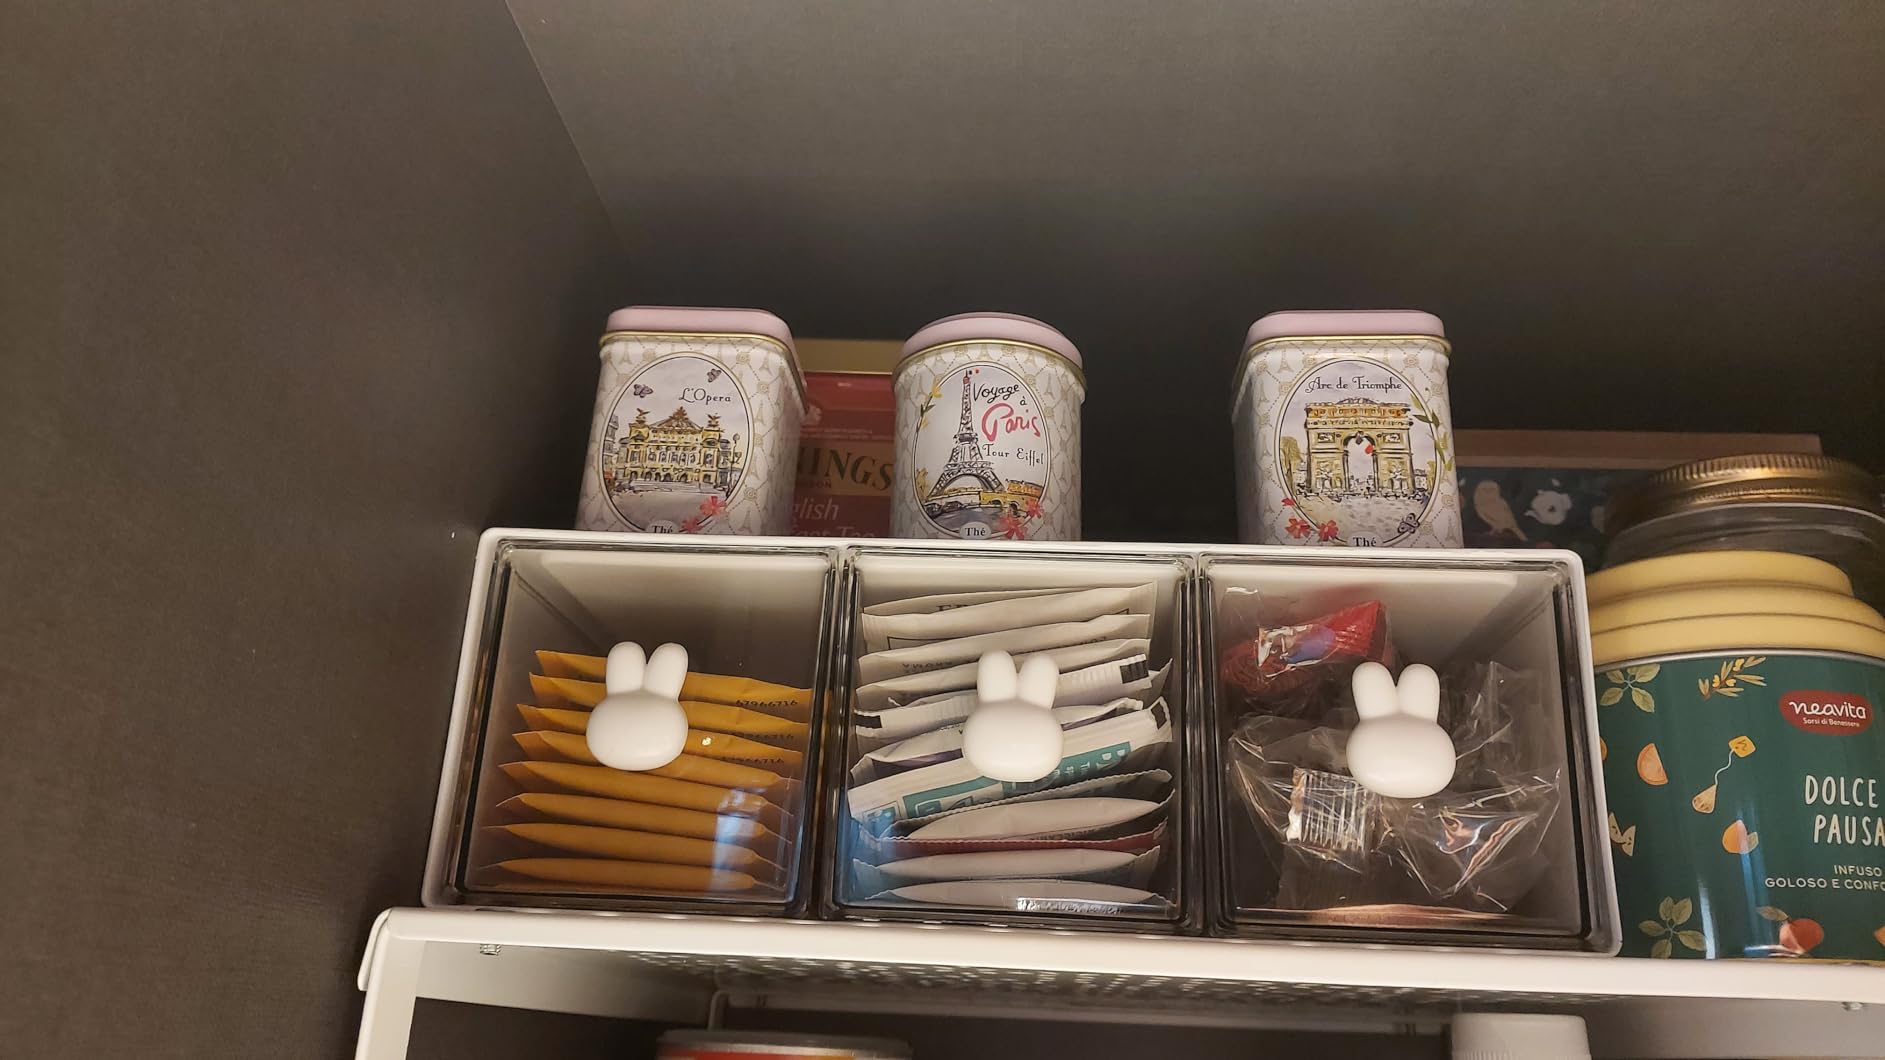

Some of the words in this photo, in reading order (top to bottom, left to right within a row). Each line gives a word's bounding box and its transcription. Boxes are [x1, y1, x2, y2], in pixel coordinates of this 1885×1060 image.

[973, 382, 1020, 404] Voyage
[1304, 376, 1333, 394] Arc
[1336, 376, 1349, 390] de
[1351, 375, 1403, 394] Triomphe
[678, 387, 732, 406] L'Opera
[1019, 395, 1028, 406] à
[981, 402, 1041, 442] Paris
[981, 443, 1010, 458] Tour
[1016, 447, 1044, 467] Eiffel
[964, 527, 986, 537] Thé
[1352, 536, 1377, 547] Thé
[1788, 701, 1867, 719] neavita
[1802, 717, 1821, 726] Sorsi
[1820, 717, 1829, 725] di
[1805, 774, 1879, 808] DOLCE
[1814, 813, 1885, 847] PAUSA
[1833, 864, 1883, 877] INFUSO
[1764, 877, 1828, 889] GOLOSO
[1831, 878, 1841, 889] E
